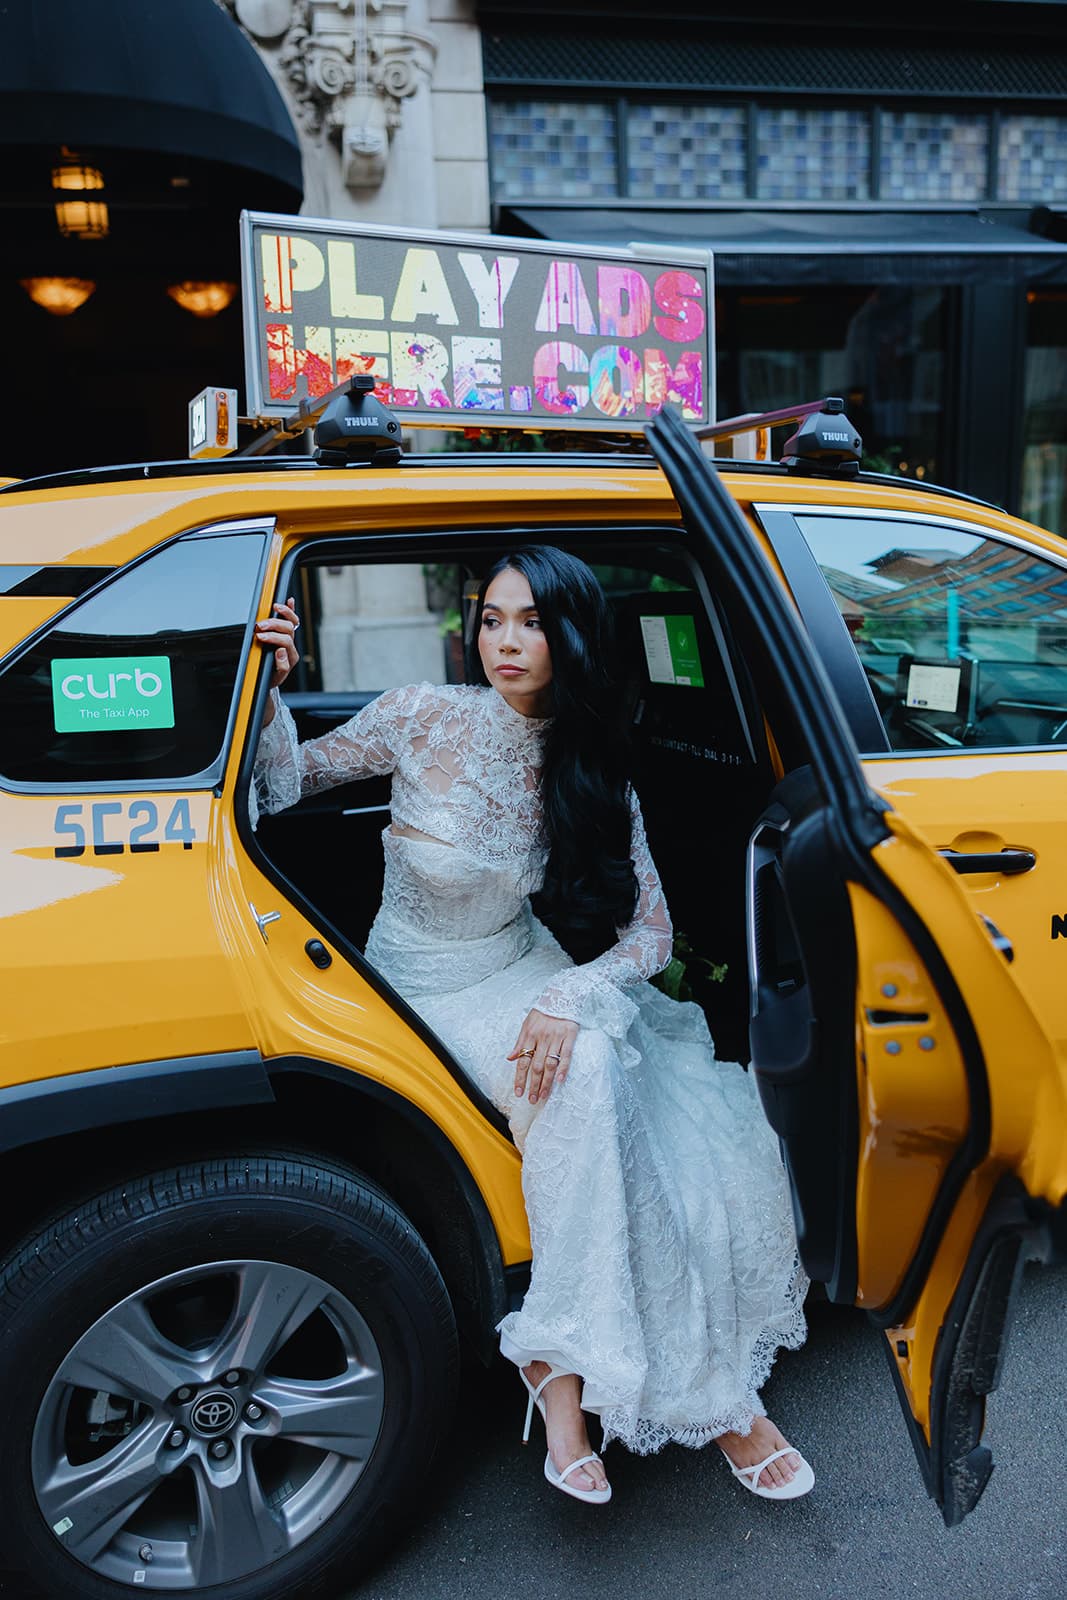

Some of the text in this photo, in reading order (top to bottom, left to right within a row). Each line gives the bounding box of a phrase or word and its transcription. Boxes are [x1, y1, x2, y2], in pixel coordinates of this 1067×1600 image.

[260, 234, 705, 343] PLAY ADS
[266, 323, 703, 419] HERE.COM
[344, 417, 379, 426] THULE
[822, 432, 849, 442] THULE
[61, 668, 162, 700] curb
[79, 706, 150, 719] The Taxi App
[54, 799, 196, 859] 5C24
